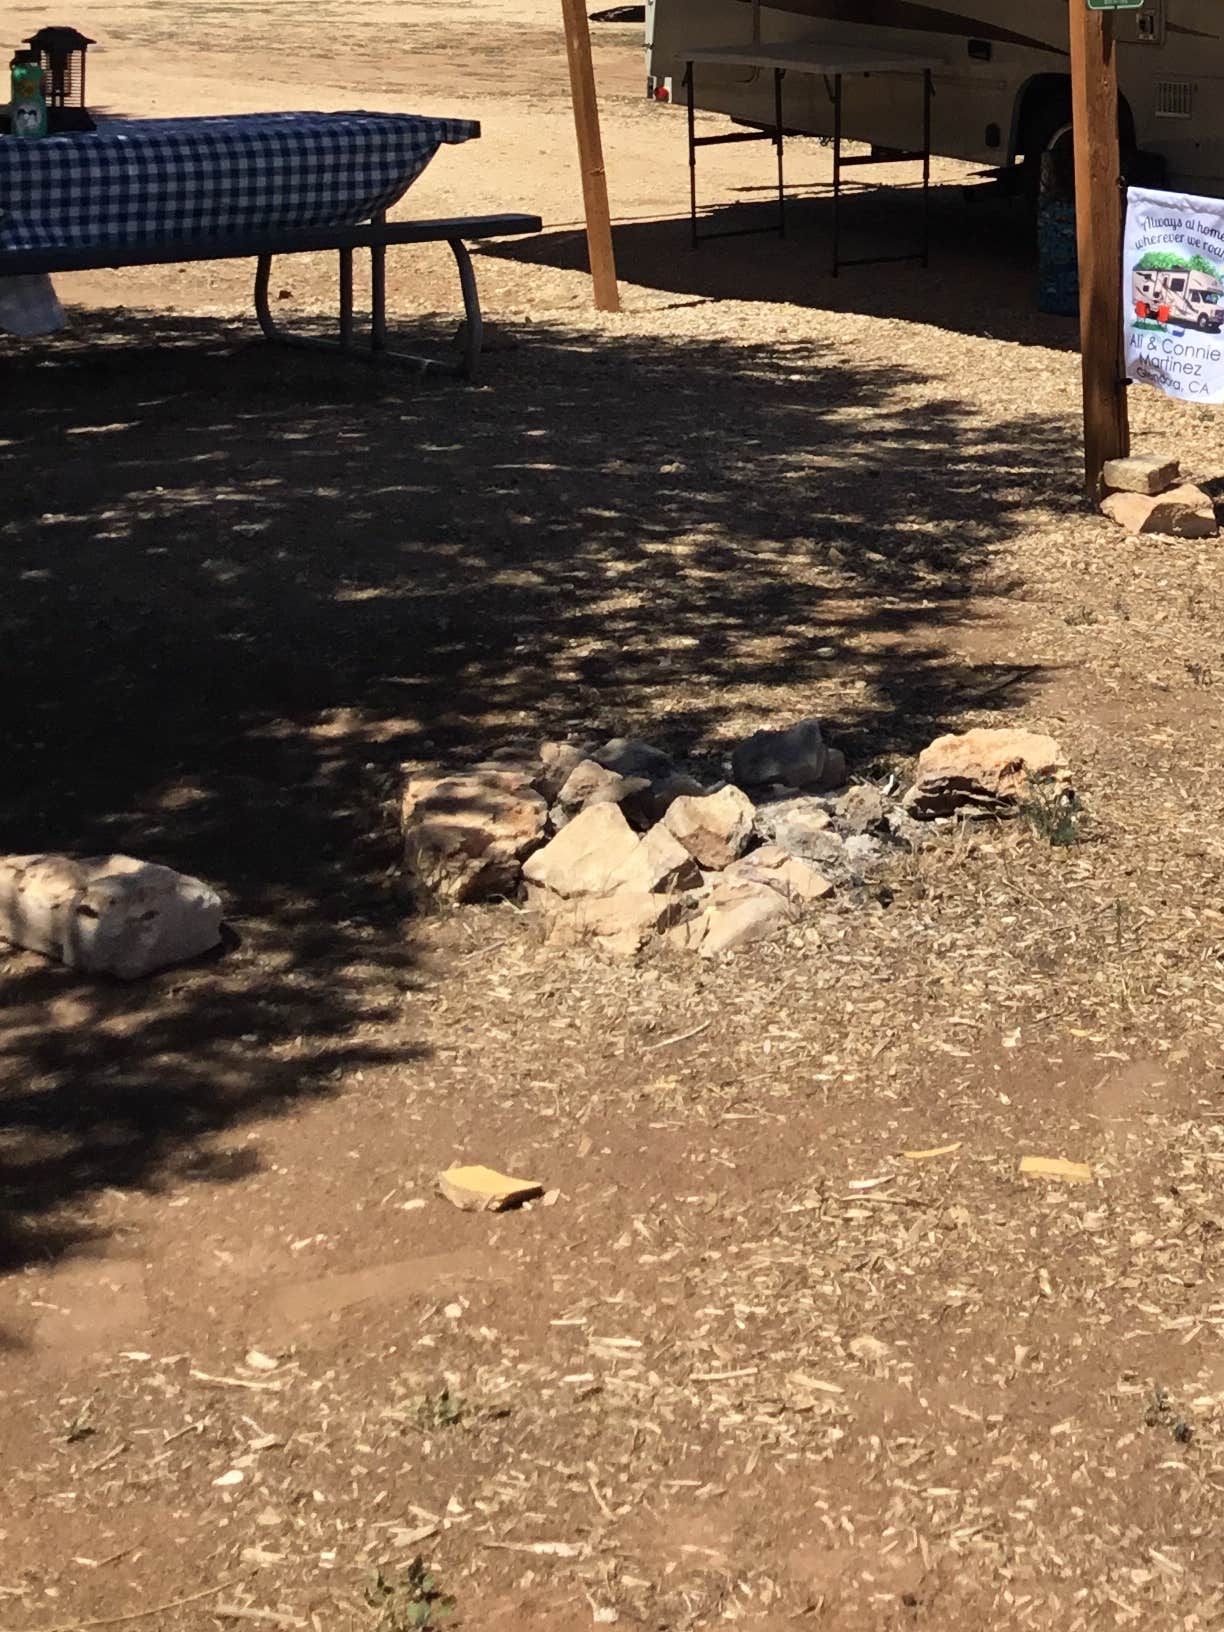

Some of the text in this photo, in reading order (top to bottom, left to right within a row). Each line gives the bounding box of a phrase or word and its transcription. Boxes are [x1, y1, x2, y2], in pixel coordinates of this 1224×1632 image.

[1142, 216, 1182, 231] Always
[1135, 233, 1185, 250] wherever
[1187, 235, 1201, 248] we
[1147, 336, 1157, 351] &
[1161, 338, 1221, 362] Connie
[1138, 352, 1202, 376] Martinez
[1188, 380, 1209, 395] CA
